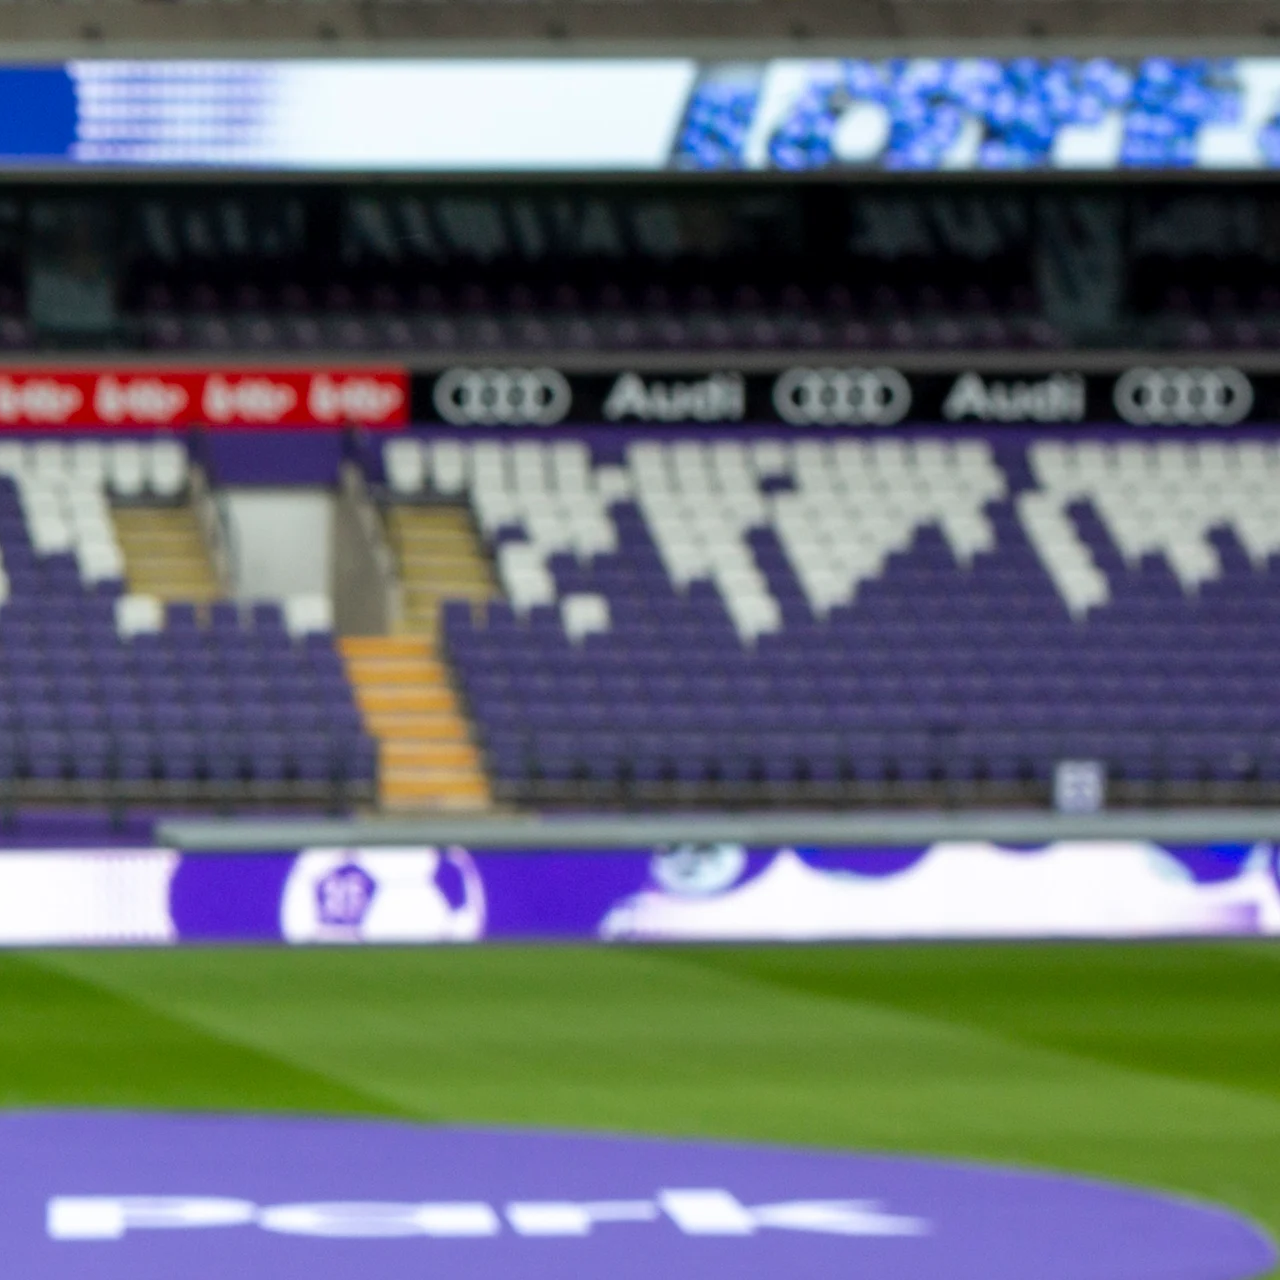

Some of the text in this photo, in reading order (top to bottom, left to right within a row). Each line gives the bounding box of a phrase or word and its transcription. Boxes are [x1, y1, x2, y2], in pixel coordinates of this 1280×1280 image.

[603, 373, 745, 421] Audi
[944, 373, 1086, 421] Audi
[47, 1188, 931, 1242] Park
